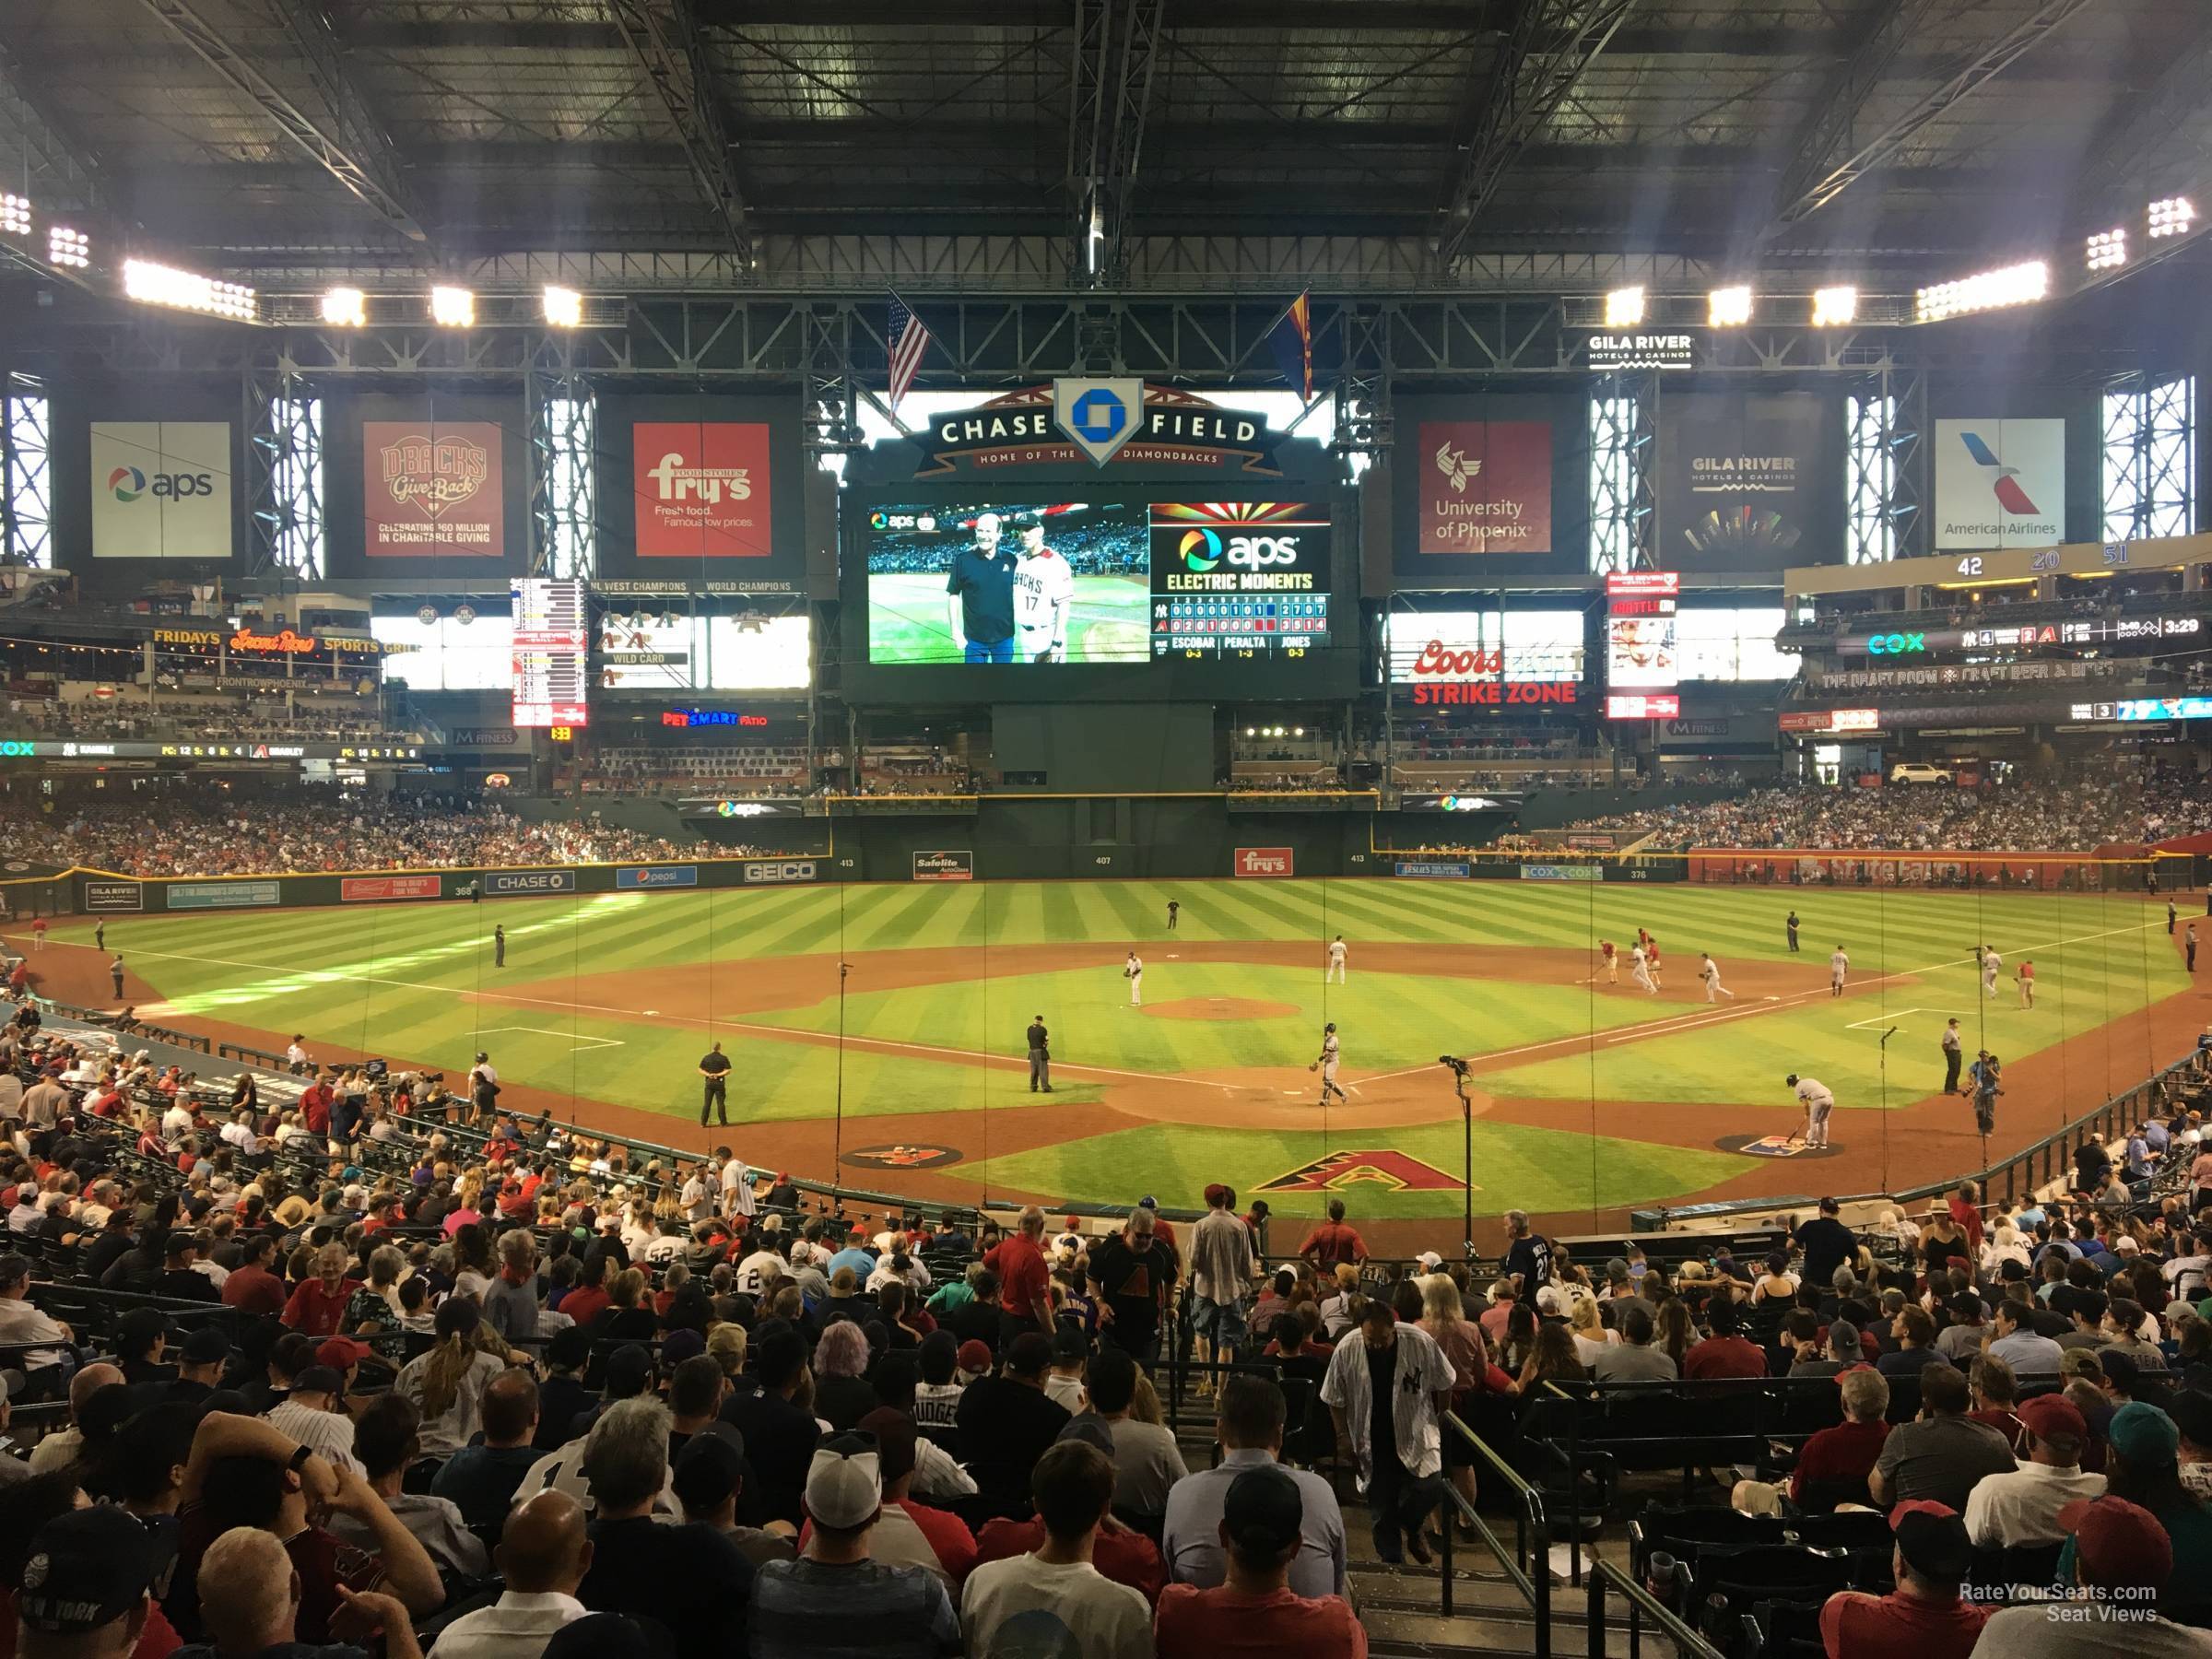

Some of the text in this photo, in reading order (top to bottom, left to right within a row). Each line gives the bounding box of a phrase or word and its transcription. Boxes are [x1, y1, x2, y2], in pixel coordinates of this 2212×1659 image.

[1589, 335, 1691, 349] GILA RIVER
[941, 415, 1255, 442] CHASE FIELD
[981, 450, 1218, 464] HOME OF THE DIAMONDBACKS
[1692, 457, 1795, 471] GILA RIVER
[647, 453, 751, 504] fry's
[674, 469, 744, 477] FOOD STORES
[151, 473, 213, 502] aps
[393, 476, 476, 500] Give Back
[654, 505, 713, 515] Fresh food.
[1436, 500, 1524, 520] University
[379, 524, 434, 532] CELEBRATING
[455, 524, 490, 532] MILLION
[664, 517, 703, 527] Famous
[704, 517, 721, 527] low
[888, 514, 915, 530] aps
[1436, 522, 1526, 538] of Phoenix
[1945, 524, 2056, 535] American Airlines
[379, 533, 490, 543] IN CHARITABLE GIVING
[1228, 536, 1298, 571] aps
[2031, 550, 2061, 571] 20
[2103, 545, 2128, 564] 51
[1958, 557, 1983, 576] 42
[590, 582, 687, 591] NL WEST CHAMPIONS
[706, 582, 791, 591] WORLD CHAMPIONS
[1167, 573, 1312, 590] ELECTRIC MOMENTS
[1025, 595, 1039, 611] 17
[2165, 619, 2199, 634] 3:29
[154, 629, 221, 645] FRIDAY'S
[1172, 637, 1215, 649] ESCOBAR
[1224, 636, 1266, 648] PERALTA
[1281, 636, 1311, 647] JONES
[1867, 632, 1924, 654] COX
[324, 639, 380, 653] SPORTS
[1288, 649, 1304, 657] 0-3
[613, 654, 665, 664] WILD CARD
[1185, 649, 1202, 658] 0-3
[1239, 649, 1253, 658] 1-3
[1414, 640, 1502, 675] Coors
[1822, 674, 1847, 688] THE
[1851, 672, 1894, 688] DRAFT
[1897, 670, 1937, 685] ROOM
[1962, 665, 2007, 682] CRAFT
[2011, 664, 2049, 680] BEER
[2053, 664, 2066, 678] &
[1414, 682, 1576, 704] STRIKE ZONE
[662, 711, 767, 726] PETSMART PATIO
[2100, 706, 2110, 717] 3
[1691, 724, 1727, 734] FITNESS
[477, 734, 513, 743] FITNESS
[161, 746, 177, 756] PC:
[179, 747, 192, 756] 12
[194, 747, 203, 756] S:
[234, 747, 241, 756] 4
[341, 748, 355, 758] PC:
[371, 748, 380, 758] S:
[384, 748, 391, 758] 7
[917, 859, 959, 867] Safelite
[1095, 856, 1112, 865] 407
[1242, 851, 1285, 872] fry's
[1351, 854, 1365, 863] 413
[651, 870, 677, 884] pepsi
[746, 864, 816, 881] GEICO
[1530, 867, 1593, 877] COX COX
[1630, 870, 1647, 879] 376
[498, 876, 547, 889] CHASE
[393, 888, 405, 896] FOR
[454, 887, 472, 897] 368
[651, 1247, 674, 1262] 52
[1536, 1254, 1548, 1281] 21
[747, 1268, 759, 1289] 2
